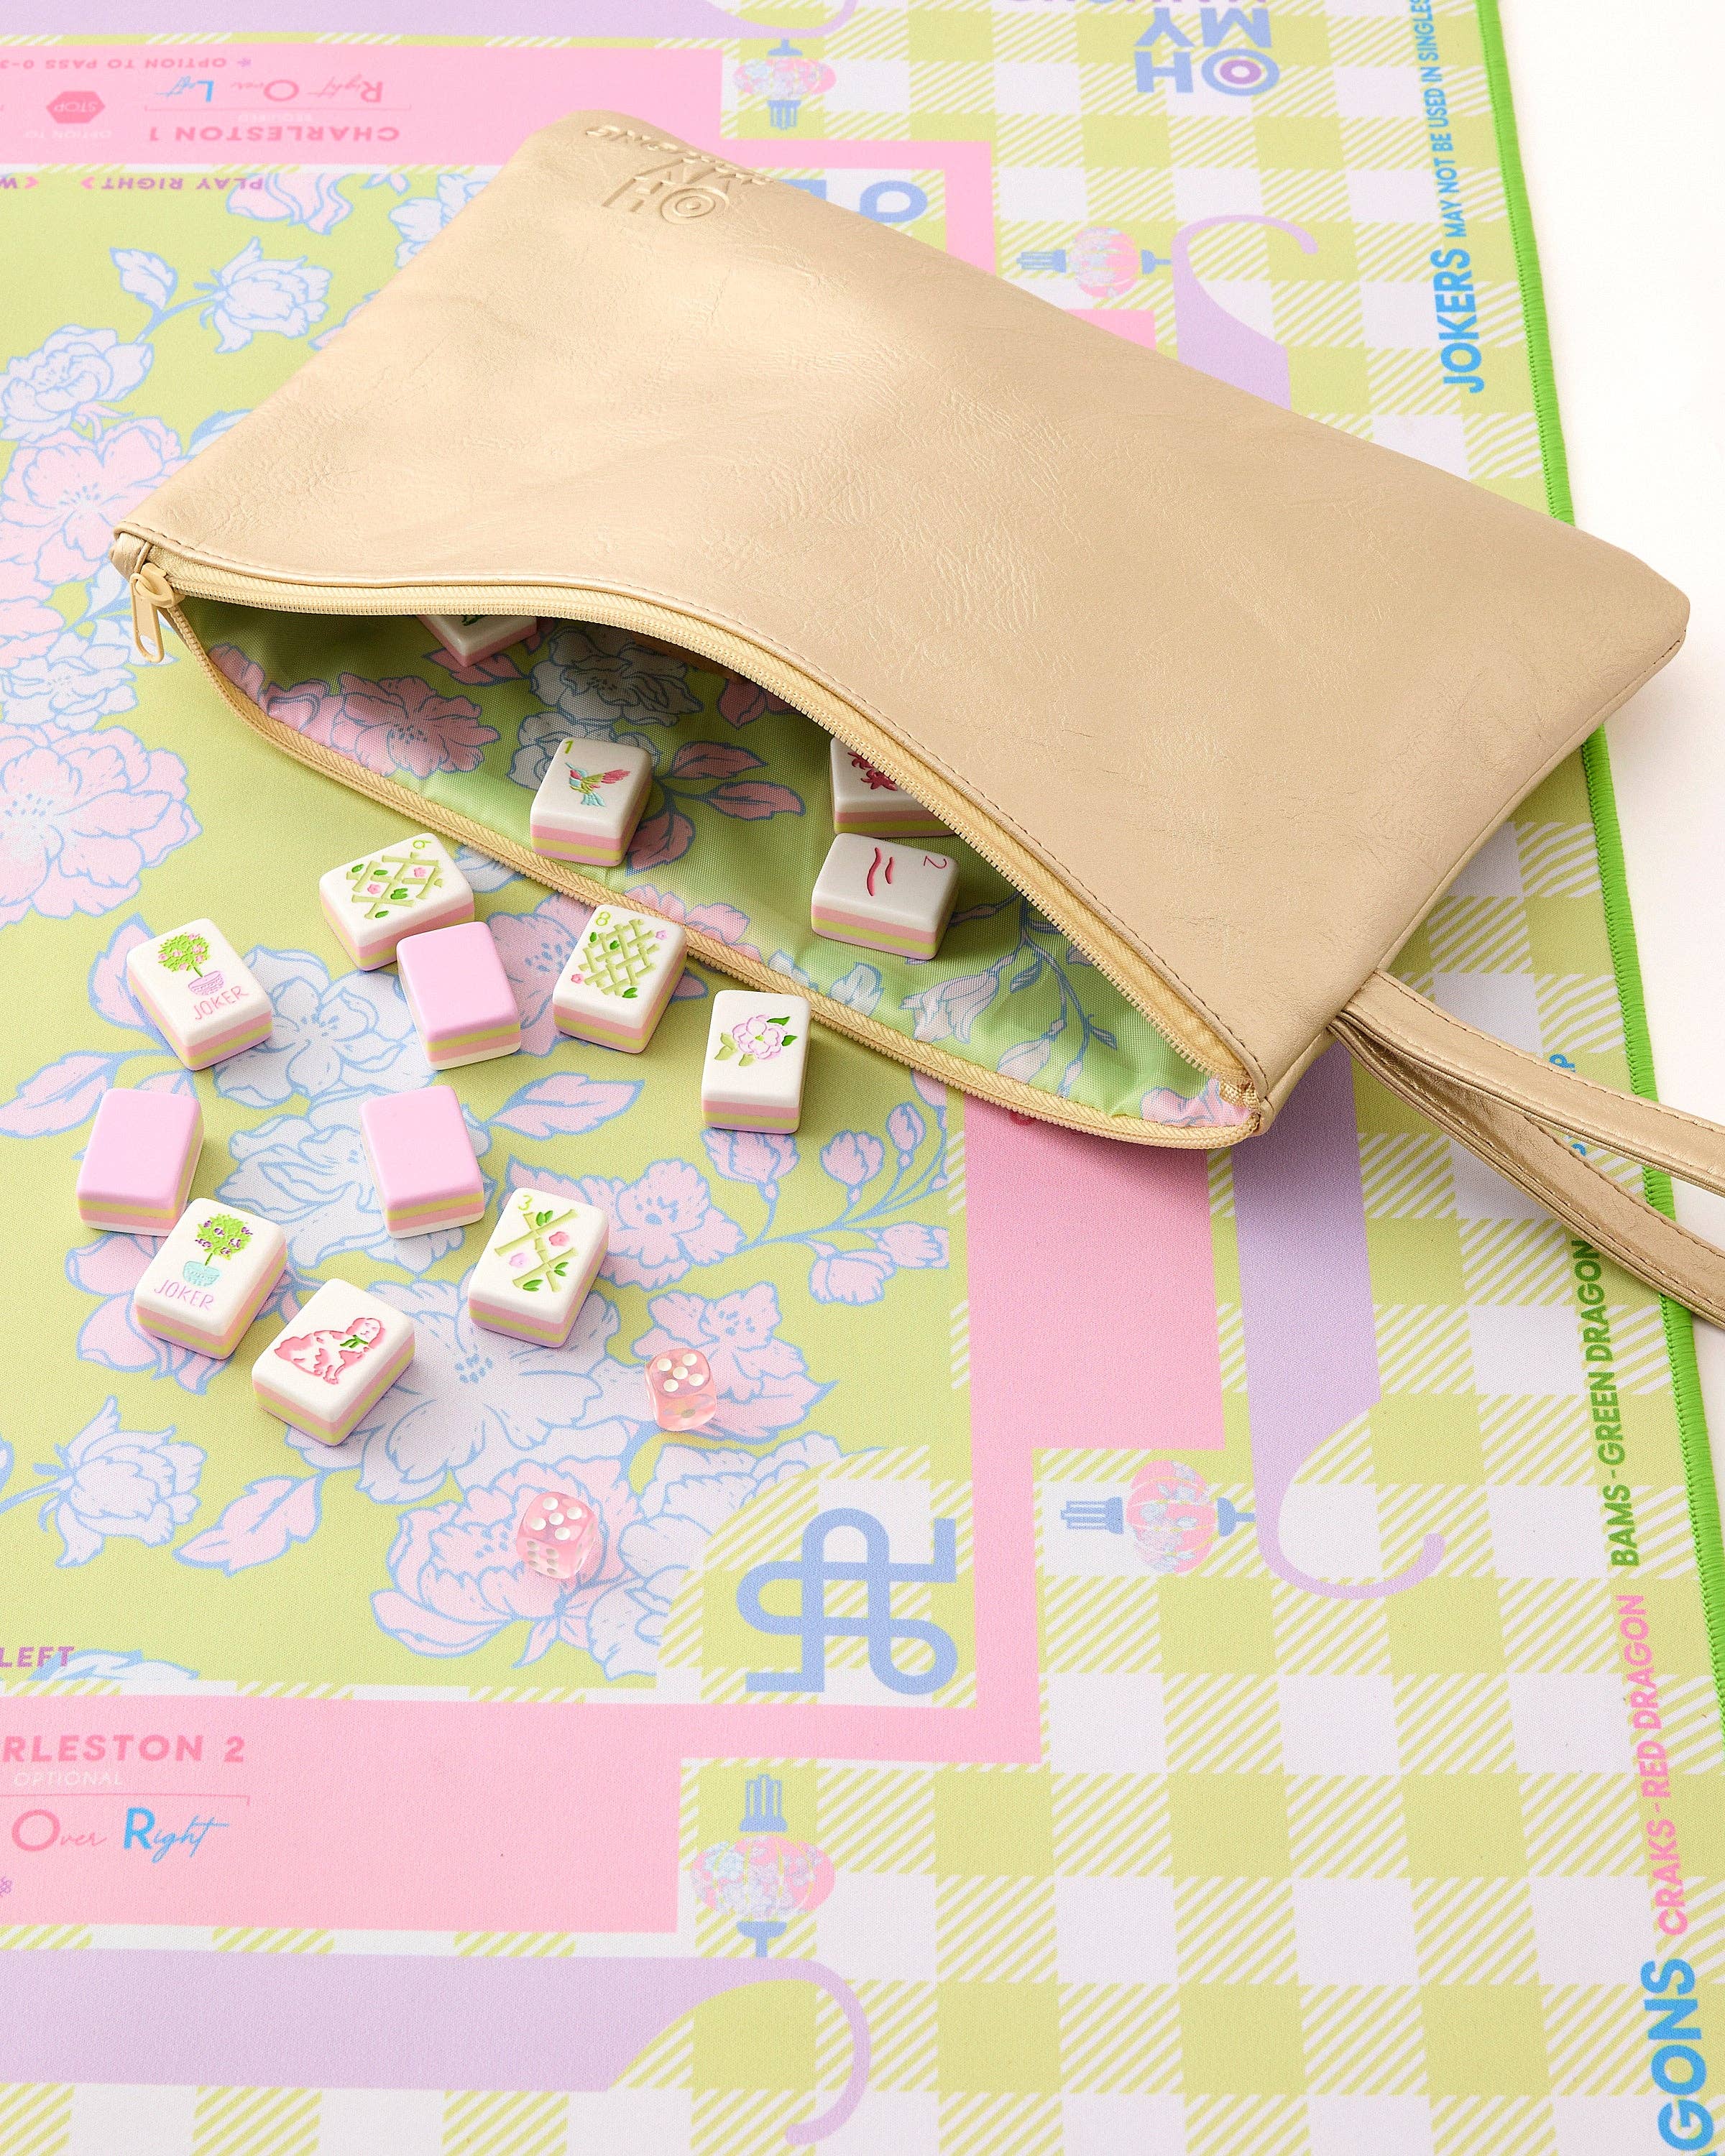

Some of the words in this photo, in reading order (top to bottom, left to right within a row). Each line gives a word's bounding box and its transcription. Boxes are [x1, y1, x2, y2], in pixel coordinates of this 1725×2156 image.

[1133, 7, 1271, 48] MY
[45, 58, 97, 70] PASS
[106, 57, 135, 70] TO
[144, 57, 227, 69] OPTION
[1136, 48, 1280, 97] OH
[1420, 66, 1441, 83] IN
[154, 75, 215, 103] Left
[230, 79, 300, 103] Over
[307, 73, 385, 103] Right
[53, 101, 97, 113] STOP
[1423, 87, 1449, 126] USED
[149, 126, 159, 142] 1
[175, 125, 400, 142] CHARLESTON
[1430, 133, 1453, 152] BE
[101, 178, 183, 190] RIGHT
[196, 178, 264, 190] PLAY
[1434, 157, 1459, 194] NOT
[1442, 201, 1467, 237] MAY
[1430, 249, 1485, 394] JOKERS
[564, 740, 574, 755] 1
[922, 855, 947, 870] 2
[594, 911, 611, 928] 8
[193, 985, 249, 1021] JOKER
[518, 1193, 533, 1211] 3
[153, 1279, 216, 1312] JOKER
[1572, 1239, 1614, 1361] DRAGON
[0, 1646, 75, 1668] LEFT
[1616, 1594, 1662, 1731] DRAGON
[2, 1733, 204, 1763] RLESTON
[224, 1735, 247, 1763] 2
[13, 1770, 122, 1787] OPTIONAL
[11, 1808, 107, 1852] Over
[123, 1806, 230, 1864] Right
[1639, 1958, 1718, 2156] GONS
